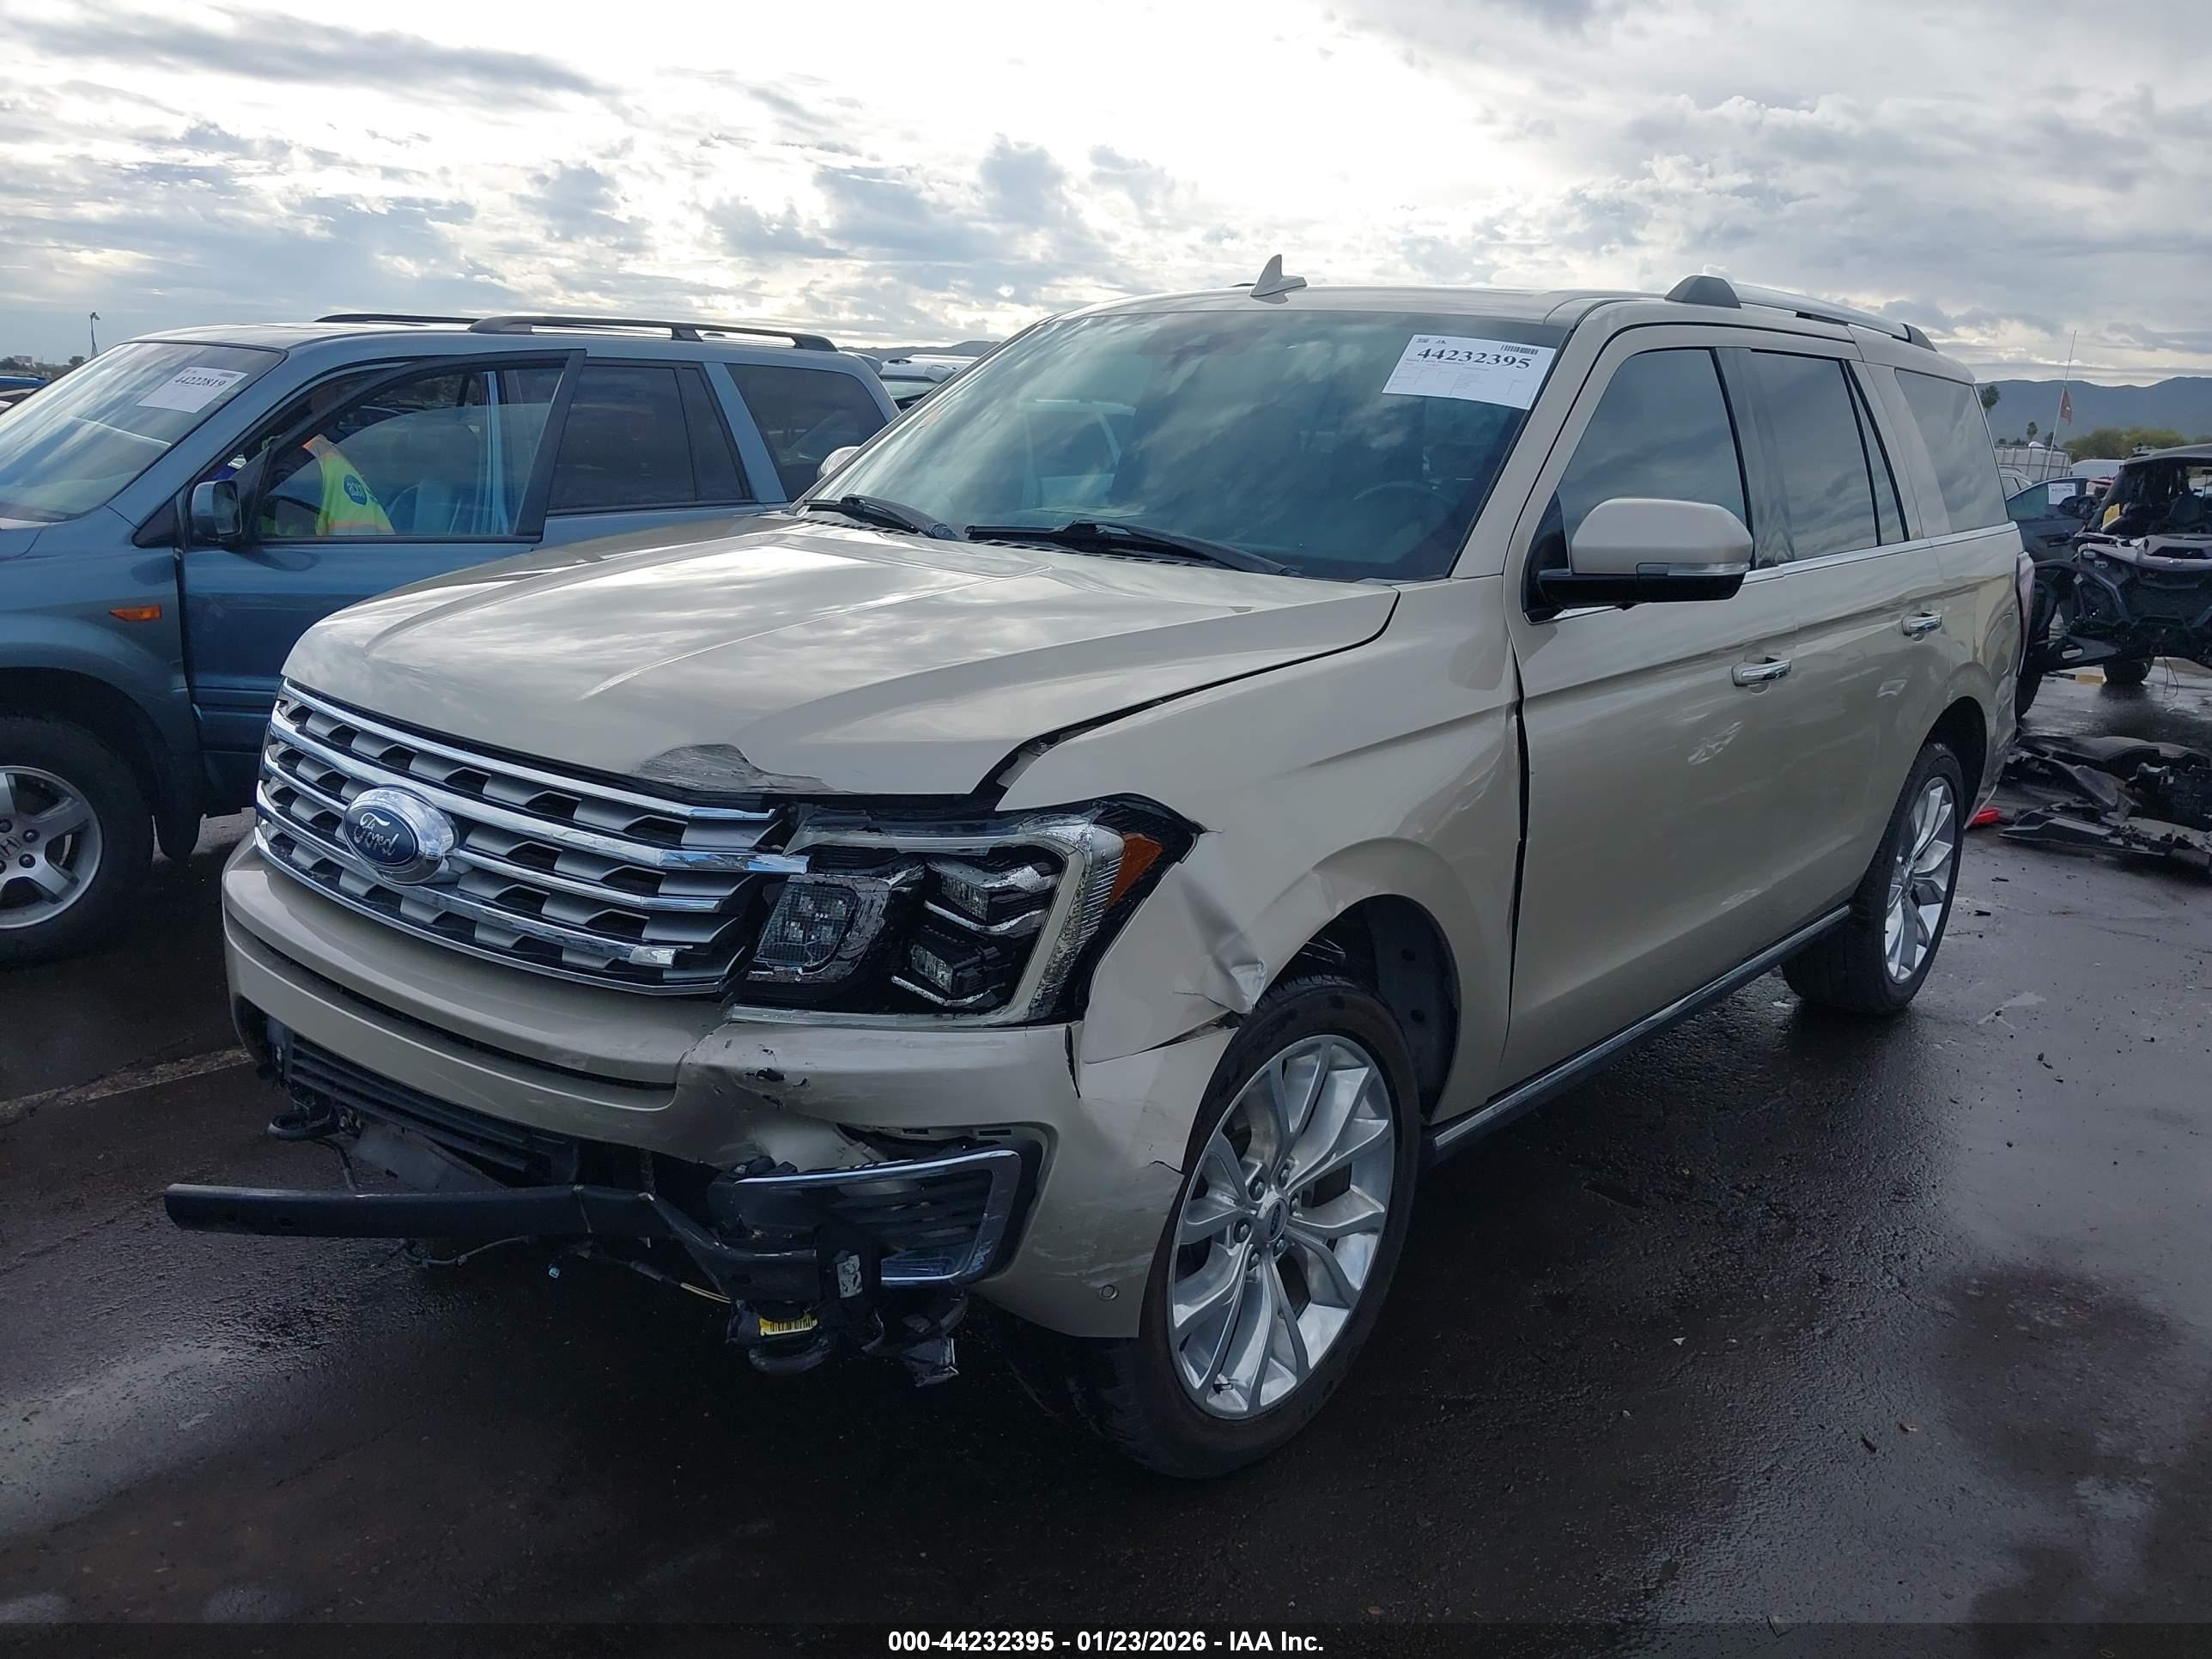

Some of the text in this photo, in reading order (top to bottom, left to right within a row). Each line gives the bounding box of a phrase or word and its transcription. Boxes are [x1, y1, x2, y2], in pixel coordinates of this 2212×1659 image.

[1417, 348, 1532, 369] 44232395
[175, 376, 227, 387] 44222819
[354, 812, 399, 856] Ford
